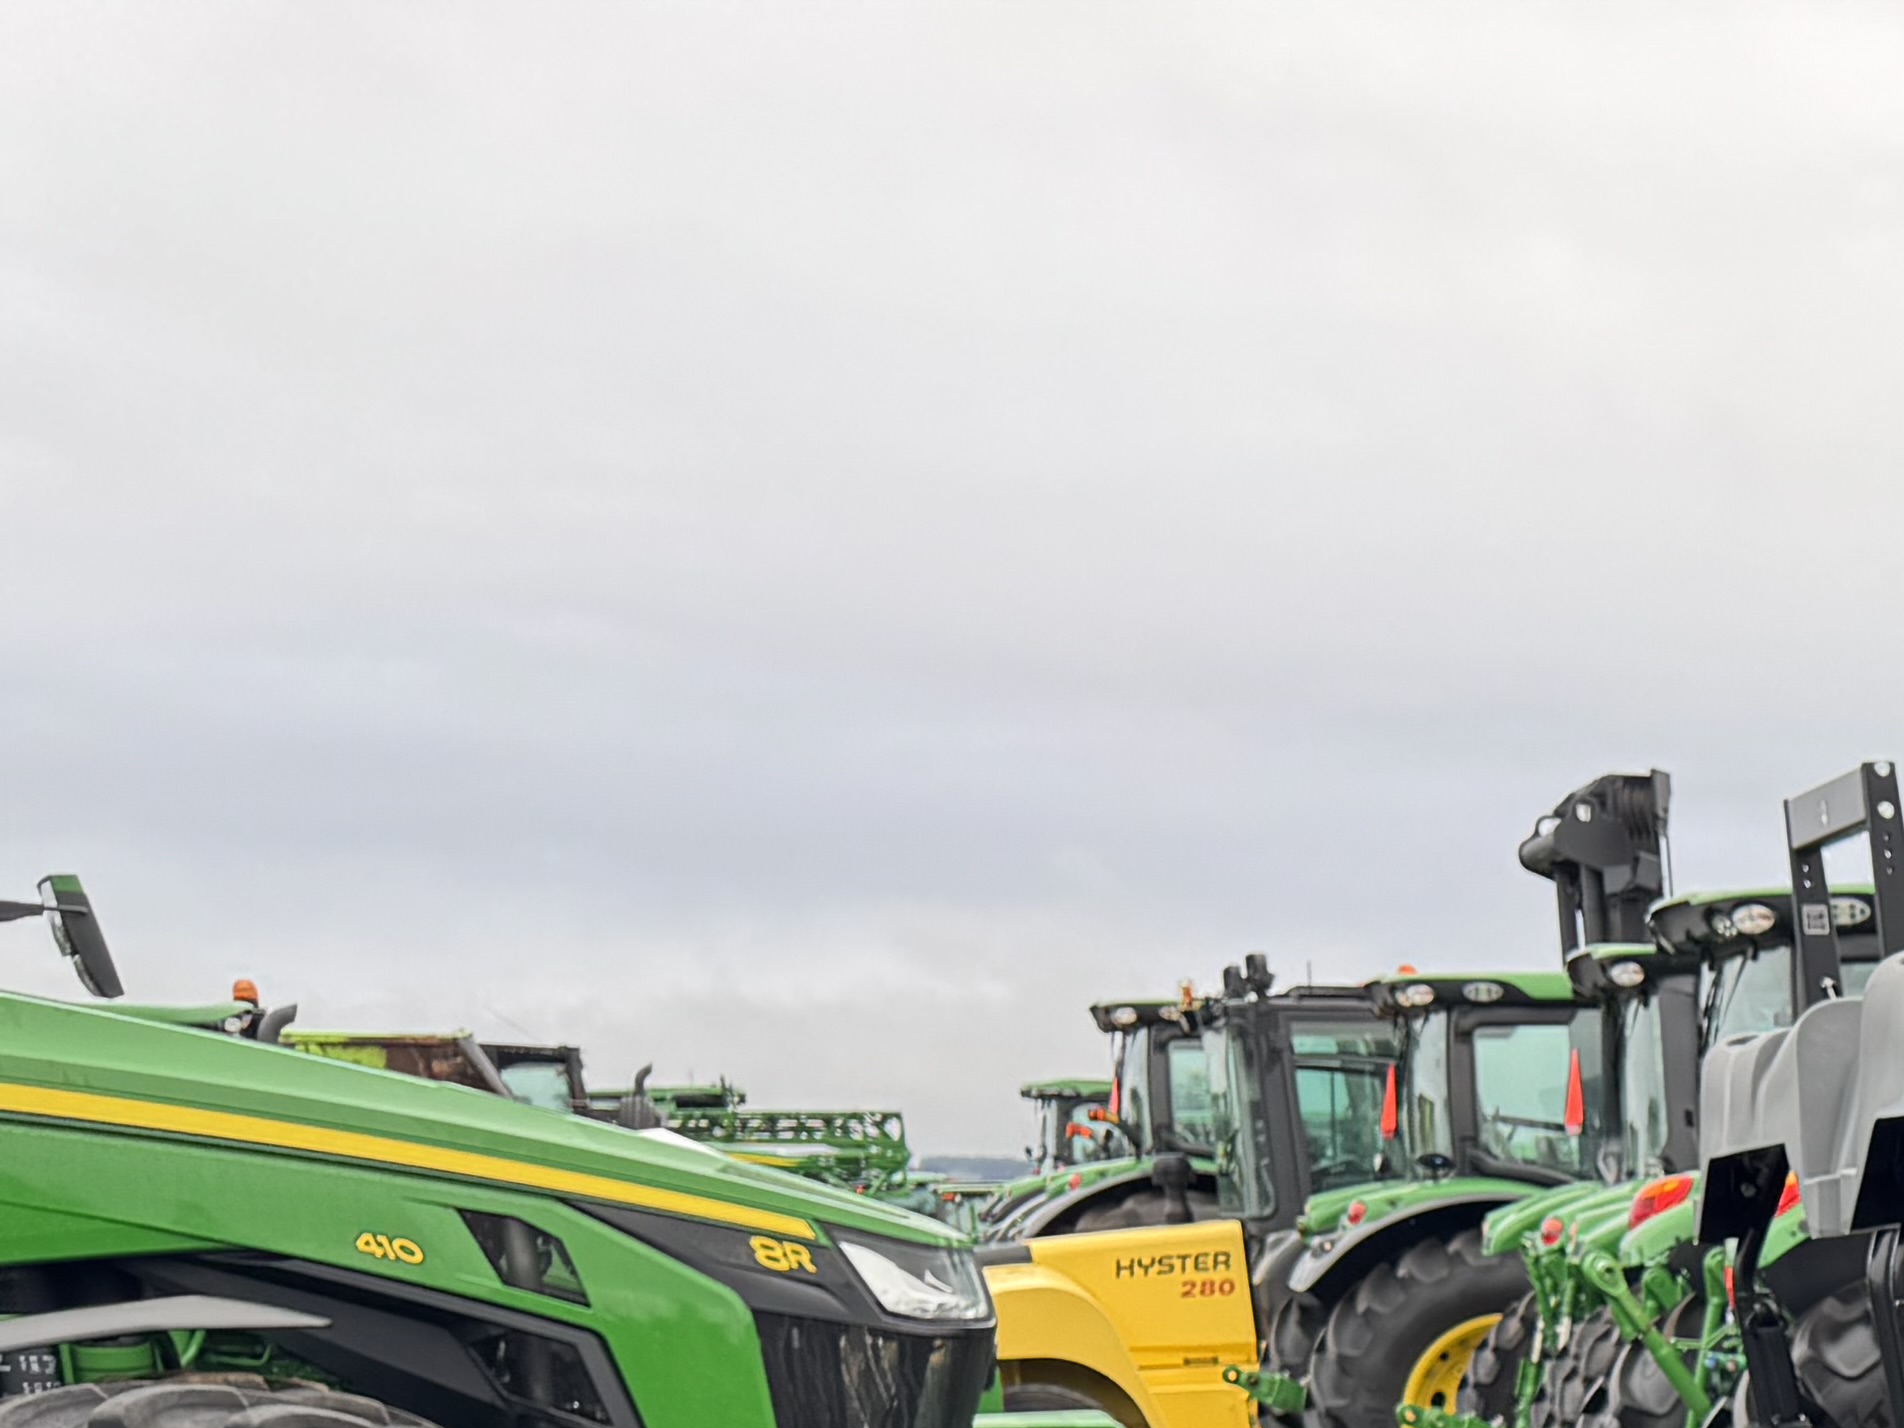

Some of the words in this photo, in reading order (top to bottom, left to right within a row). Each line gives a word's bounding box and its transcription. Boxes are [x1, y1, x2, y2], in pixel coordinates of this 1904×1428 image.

[355, 1232, 425, 1266] 410
[748, 1235, 817, 1275] 8R
[1115, 1250, 1232, 1279] HYSTER
[1180, 1277, 1236, 1299] 280
